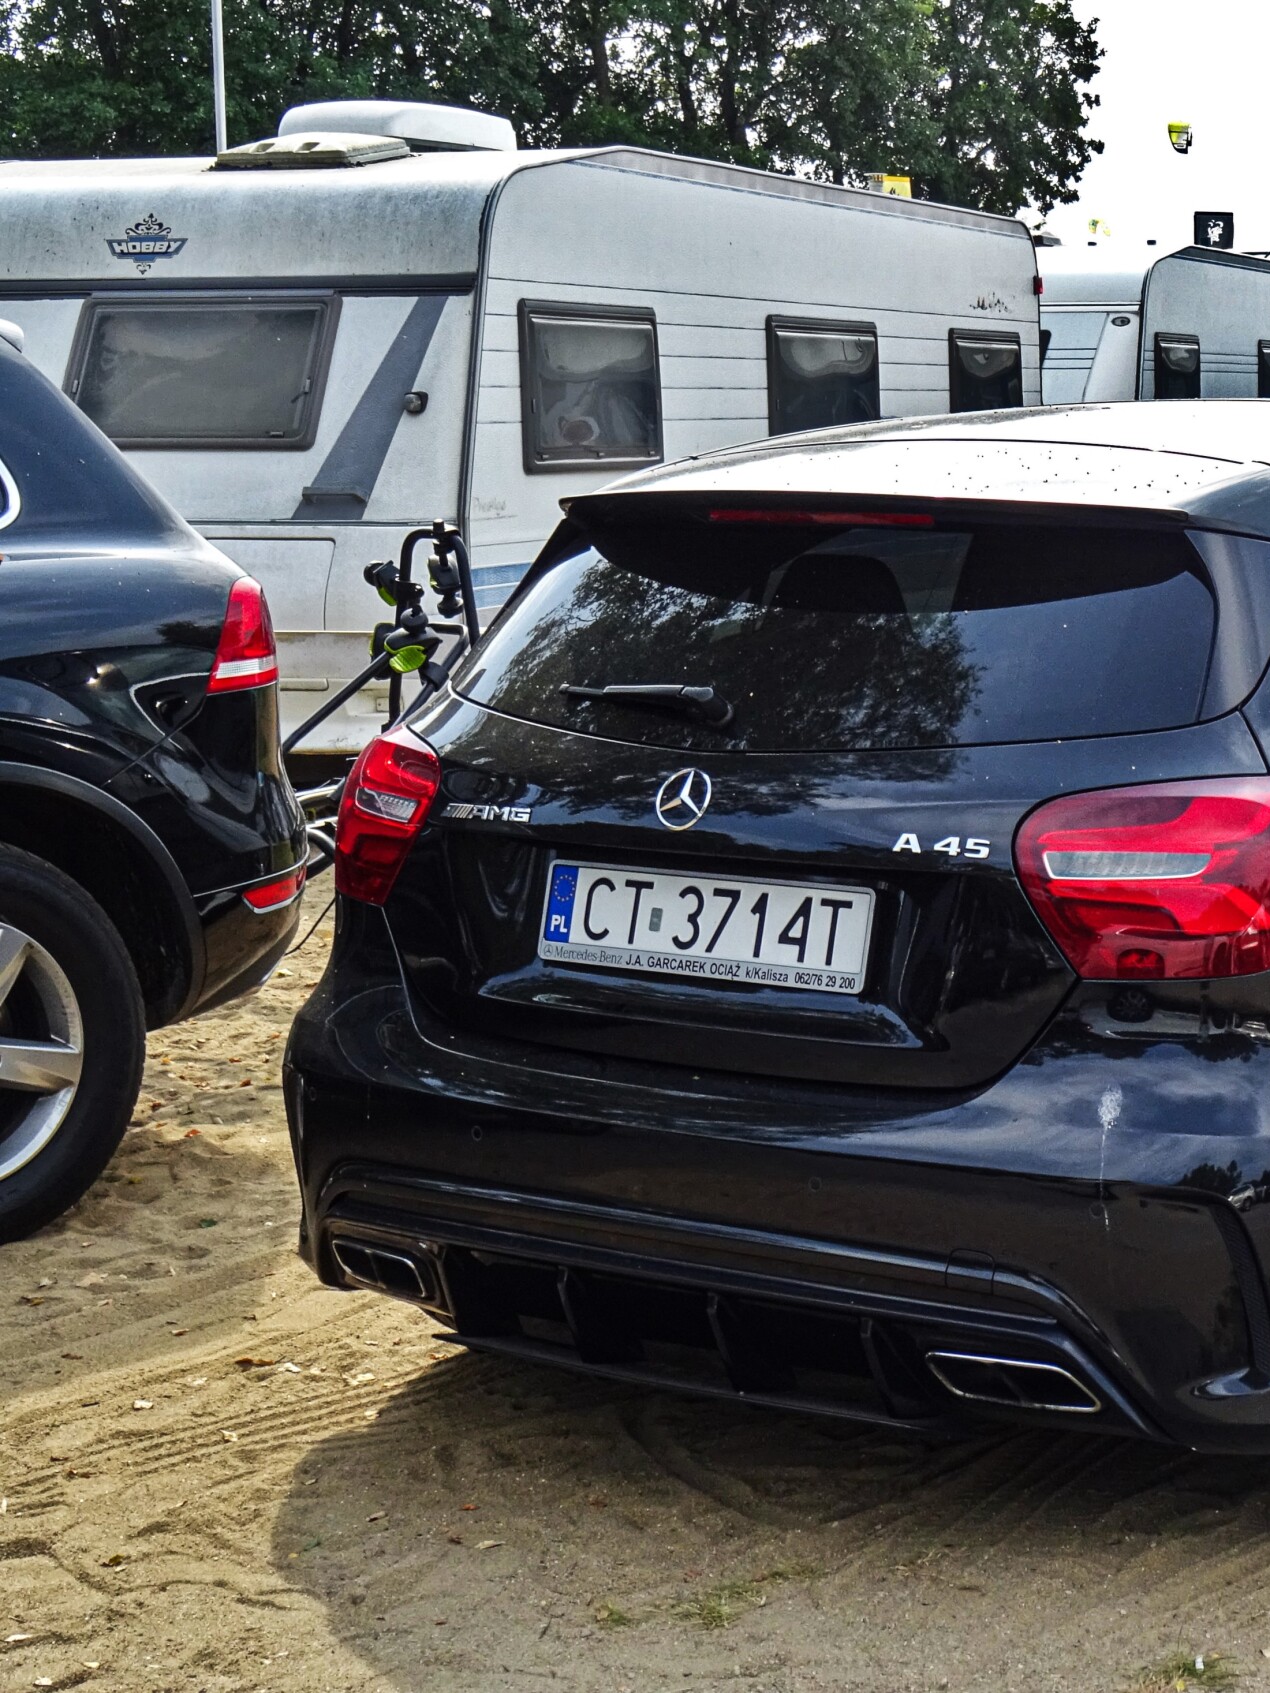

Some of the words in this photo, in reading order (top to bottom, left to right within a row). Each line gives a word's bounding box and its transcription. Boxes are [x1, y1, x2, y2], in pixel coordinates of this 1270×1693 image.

[112, 241, 182, 253] HOBBY
[470, 804, 531, 823] AMG
[892, 833, 921, 854] A
[933, 836, 991, 859] 45
[551, 914, 567, 933] PL
[583, 877, 654, 945] CT
[671, 885, 853, 967] 3714T
[554, 946, 623, 965] Mercedes-Benz
[625, 953, 644, 967] J.A.
[647, 956, 707, 974] GARCAREK
[710, 962, 741, 980] OCIĄŻ
[745, 966, 789, 983] k/Kalisza
[794, 972, 823, 987] 062/76
[825, 975, 837, 988] 29
[839, 977, 856, 990] 200
